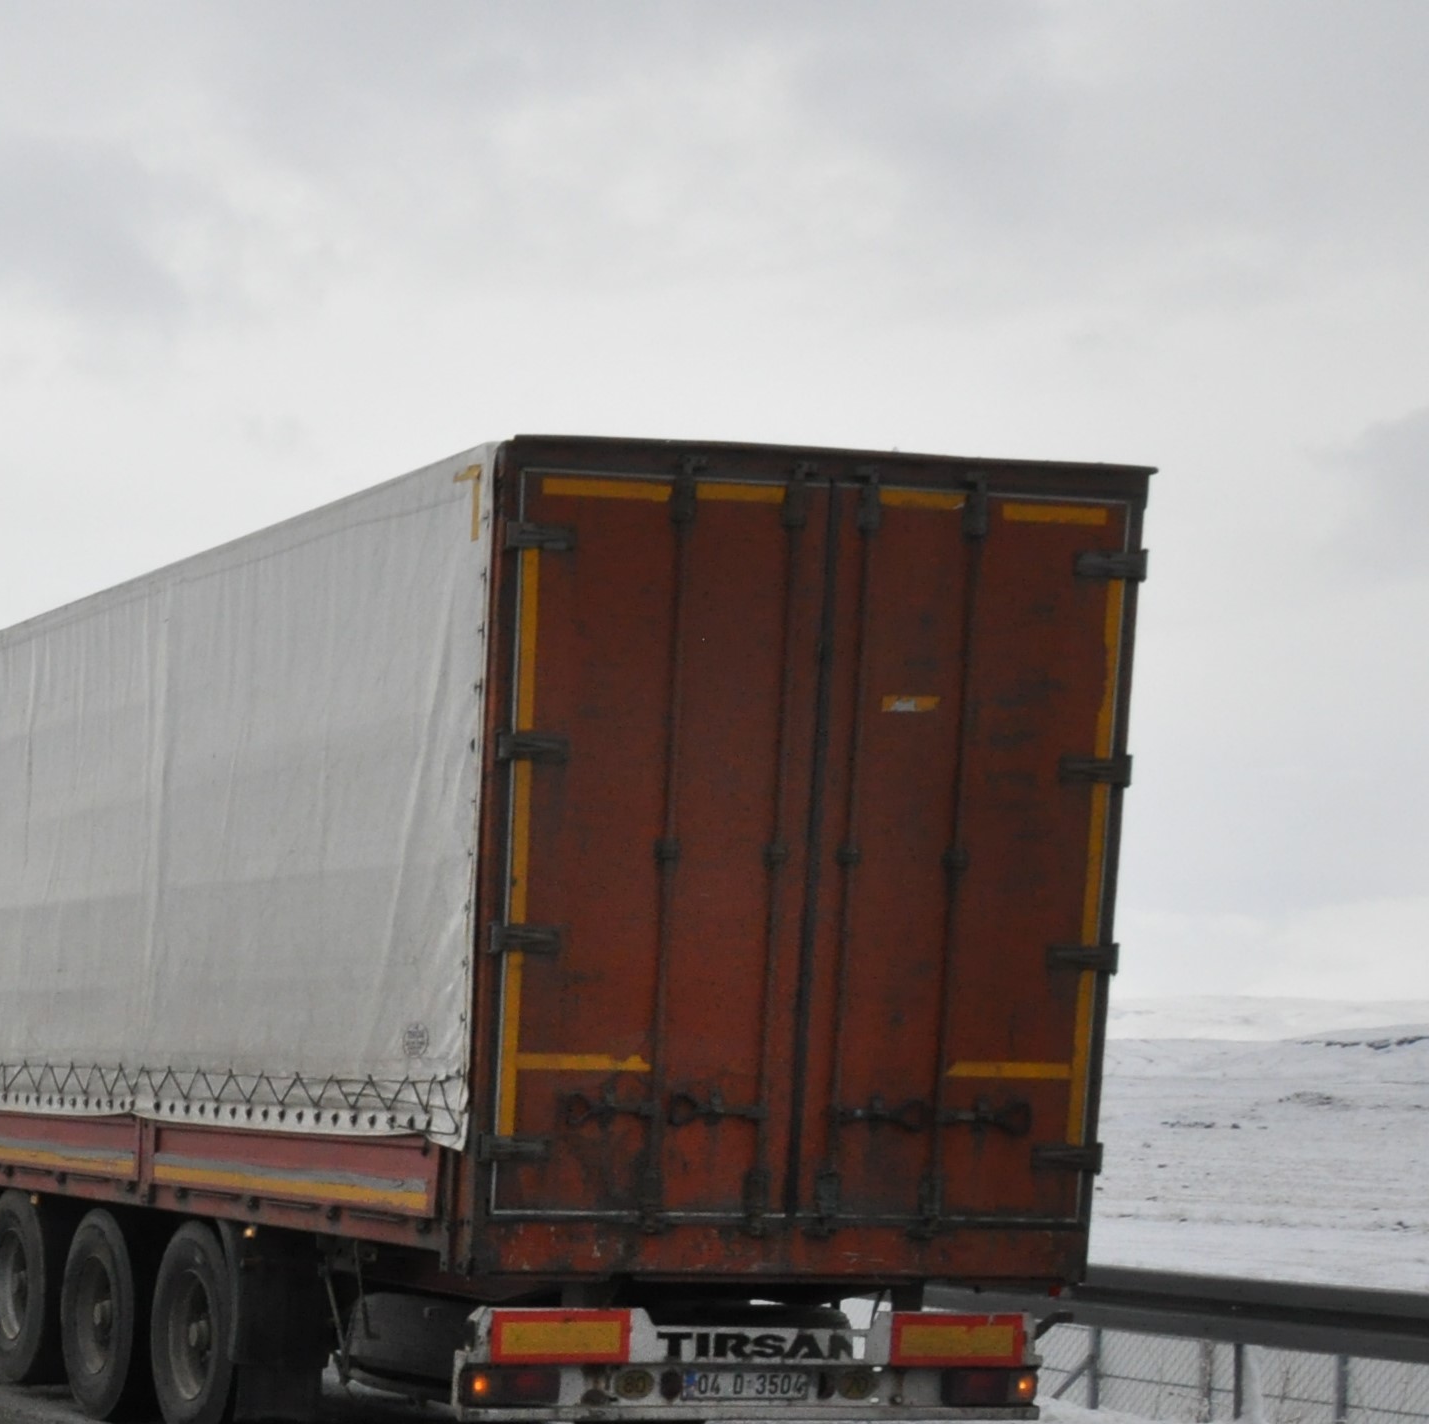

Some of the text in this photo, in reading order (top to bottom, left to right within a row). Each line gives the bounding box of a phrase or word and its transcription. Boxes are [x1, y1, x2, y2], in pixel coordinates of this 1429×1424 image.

[657, 1331, 865, 1360] TIRSAN
[697, 1374, 721, 1395] 04
[754, 1374, 806, 1395] 3504
